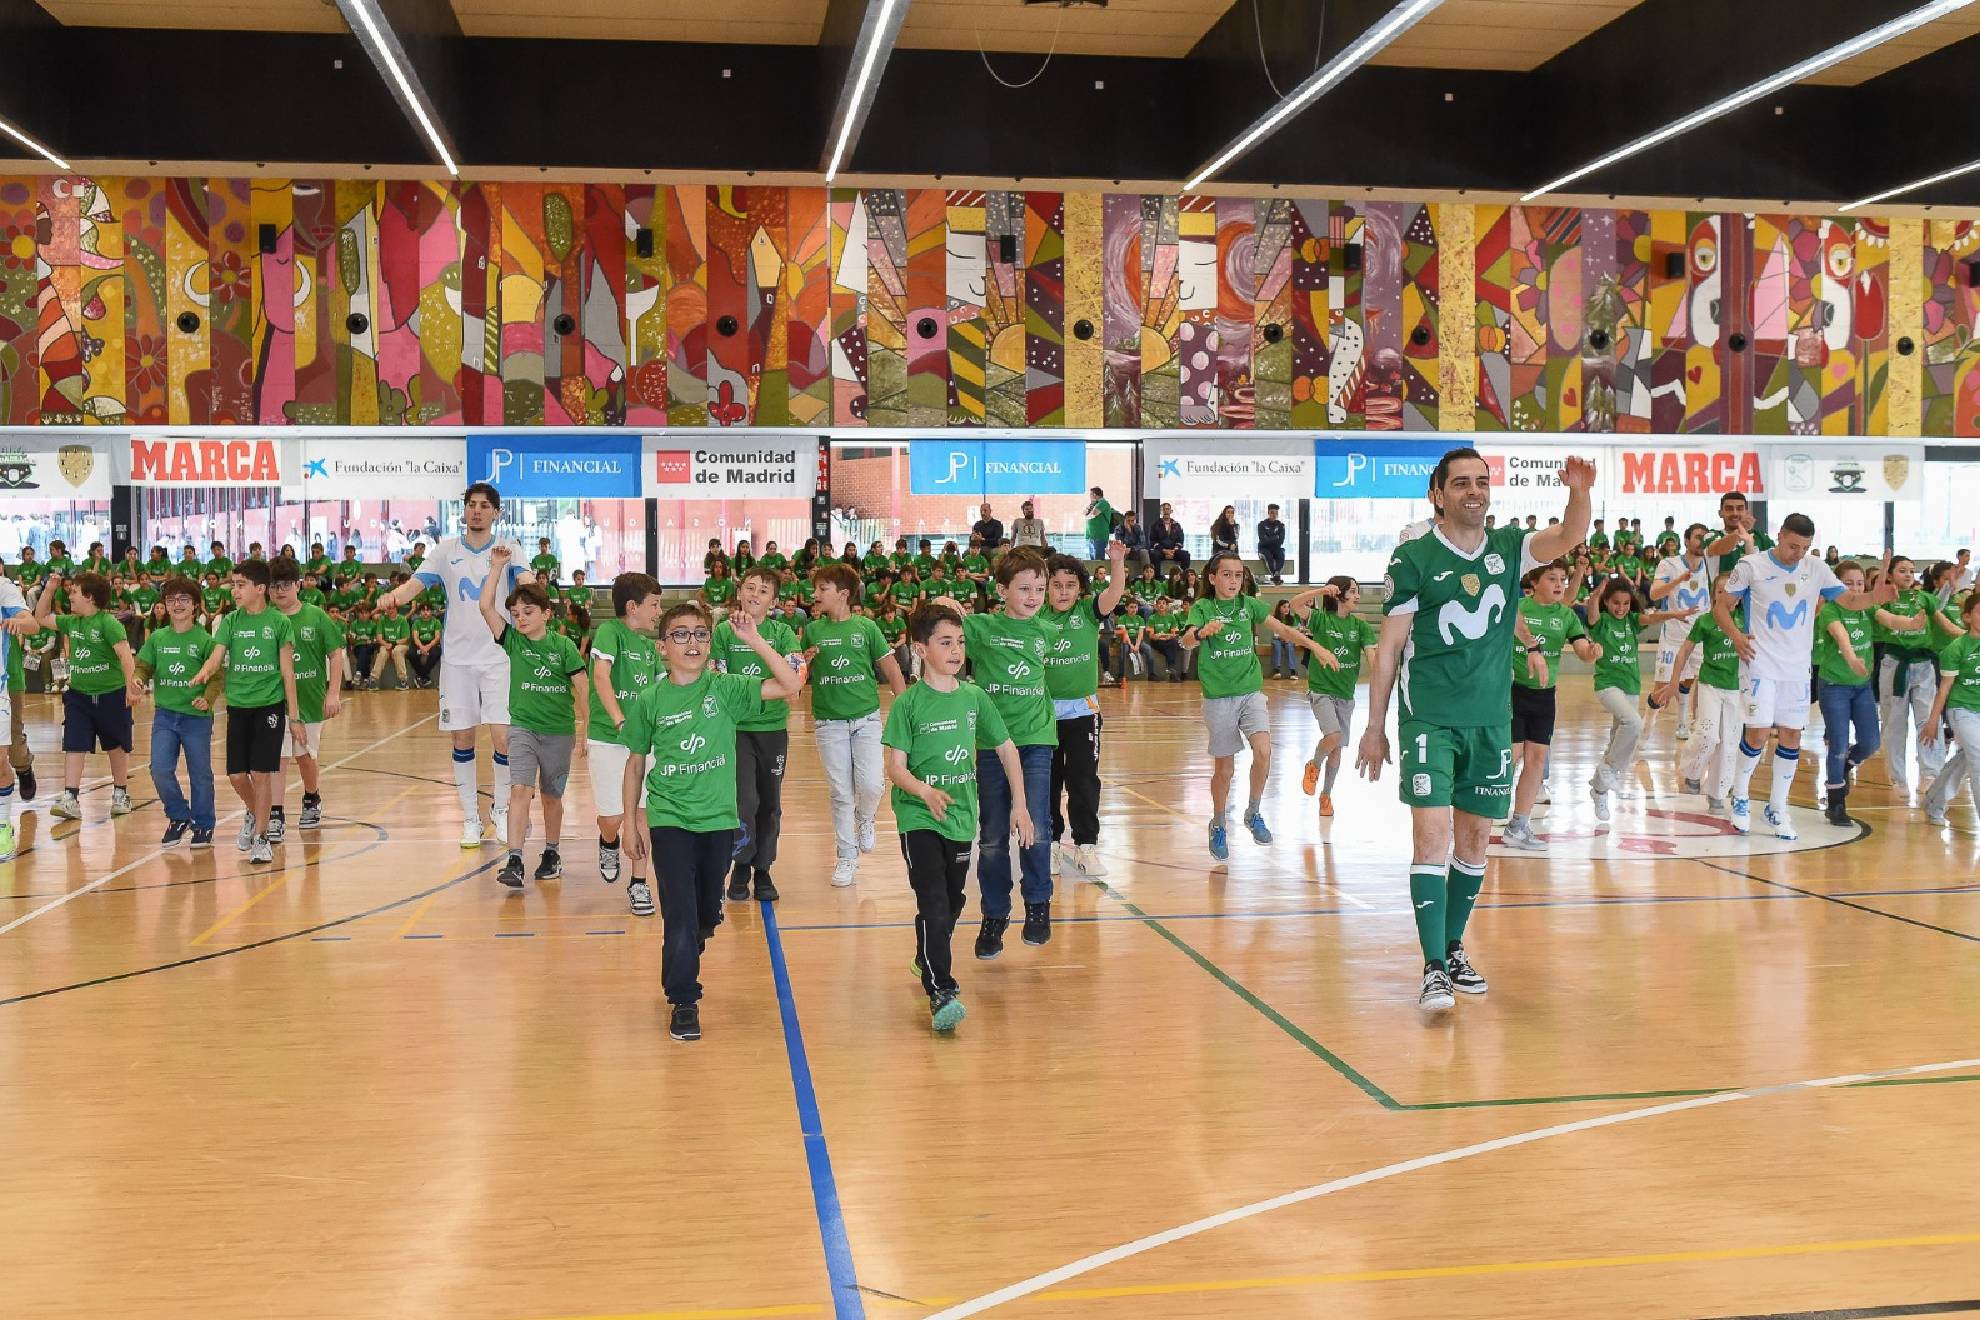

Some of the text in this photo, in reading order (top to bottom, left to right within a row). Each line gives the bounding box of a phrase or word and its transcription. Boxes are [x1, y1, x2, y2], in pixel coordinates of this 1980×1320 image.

[131, 440, 280, 480] MARCA
[695, 450, 796, 464] Comunidad
[1509, 456, 1566, 468] Comun
[335, 460, 402, 474] Fundación
[532, 460, 622, 474] FINANCIAL
[985, 462, 1061, 474] FINANCIAL
[1187, 460, 1249, 474] Fundación
[1623, 453, 1764, 494] MARCA
[695, 469, 795, 484] de Madrid
[1509, 474, 1530, 487] de
[1751, 678, 1760, 696] 7
[1415, 733, 1428, 764] 1
[660, 753, 726, 776] JP Financial
